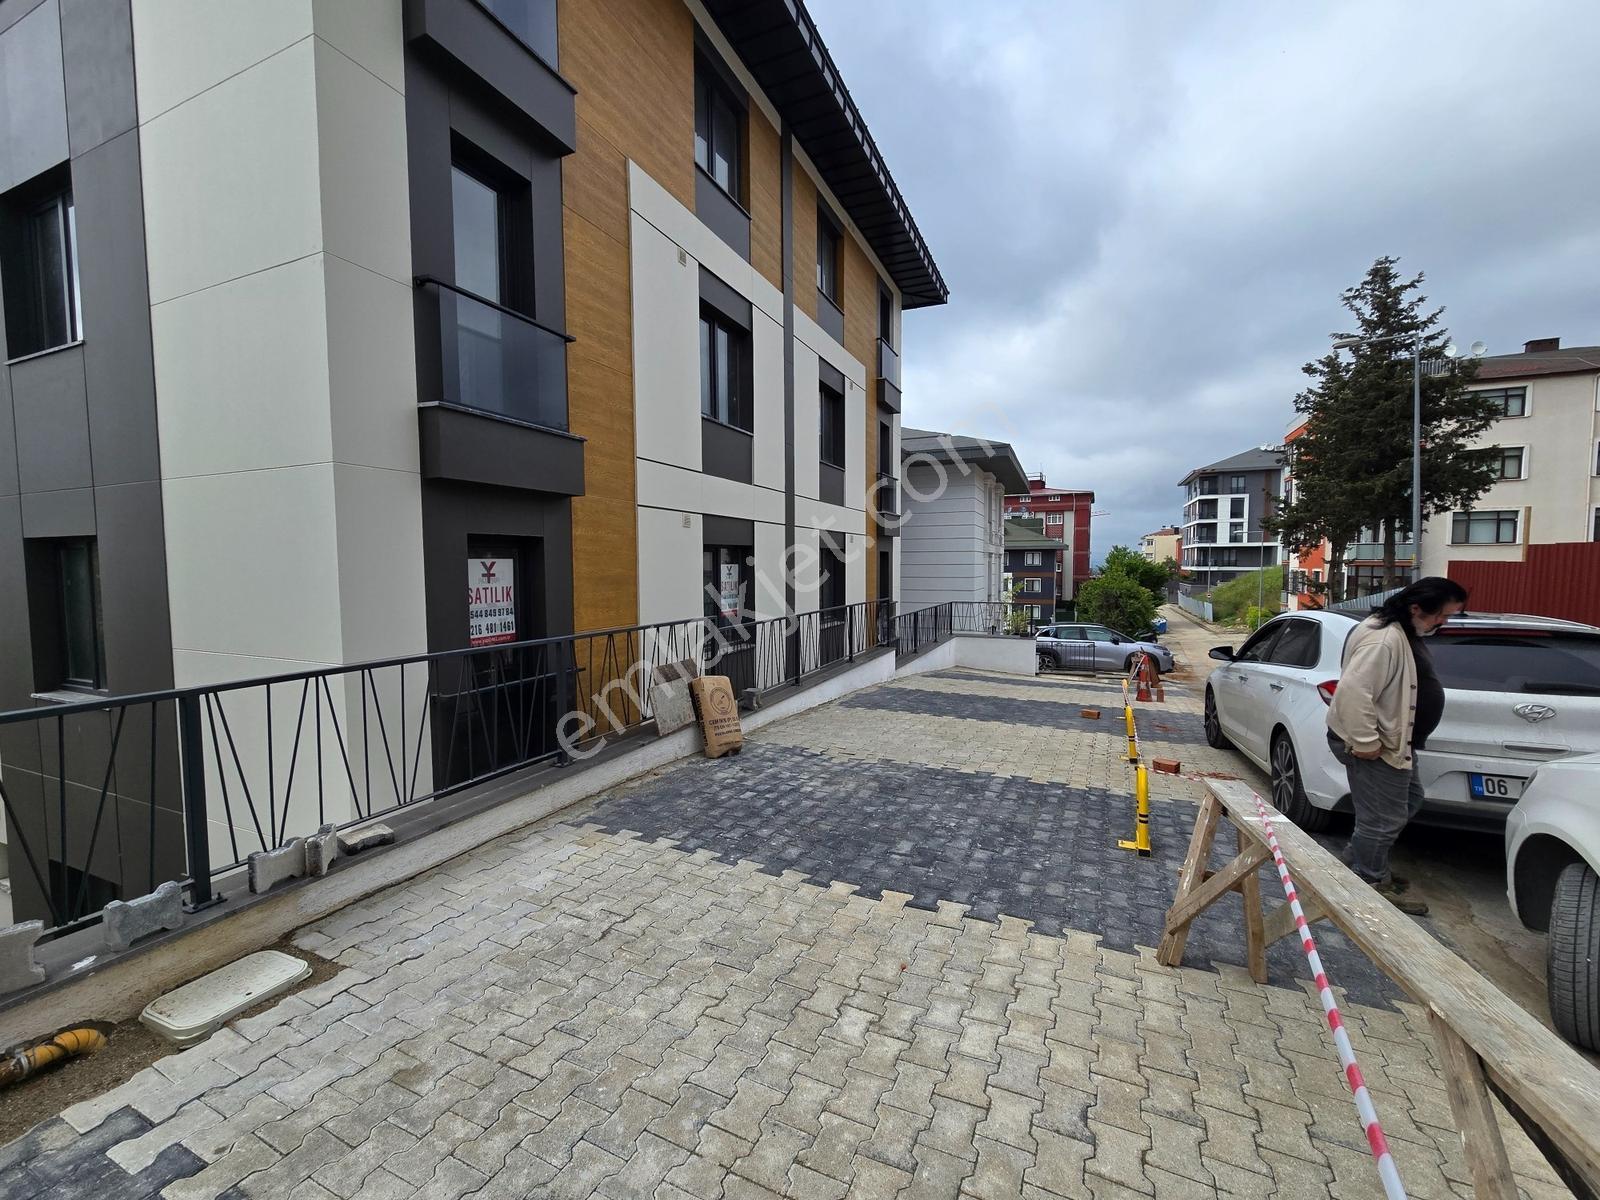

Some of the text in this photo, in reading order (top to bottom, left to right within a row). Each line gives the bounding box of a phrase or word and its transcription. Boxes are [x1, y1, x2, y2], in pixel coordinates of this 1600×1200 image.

[468, 586, 512, 605] SATILIK
[470, 610, 483, 619] 544
[484, 608, 496, 618] 849
[470, 621, 514, 635] 216 481 1461
[1485, 778, 1508, 795] 06
